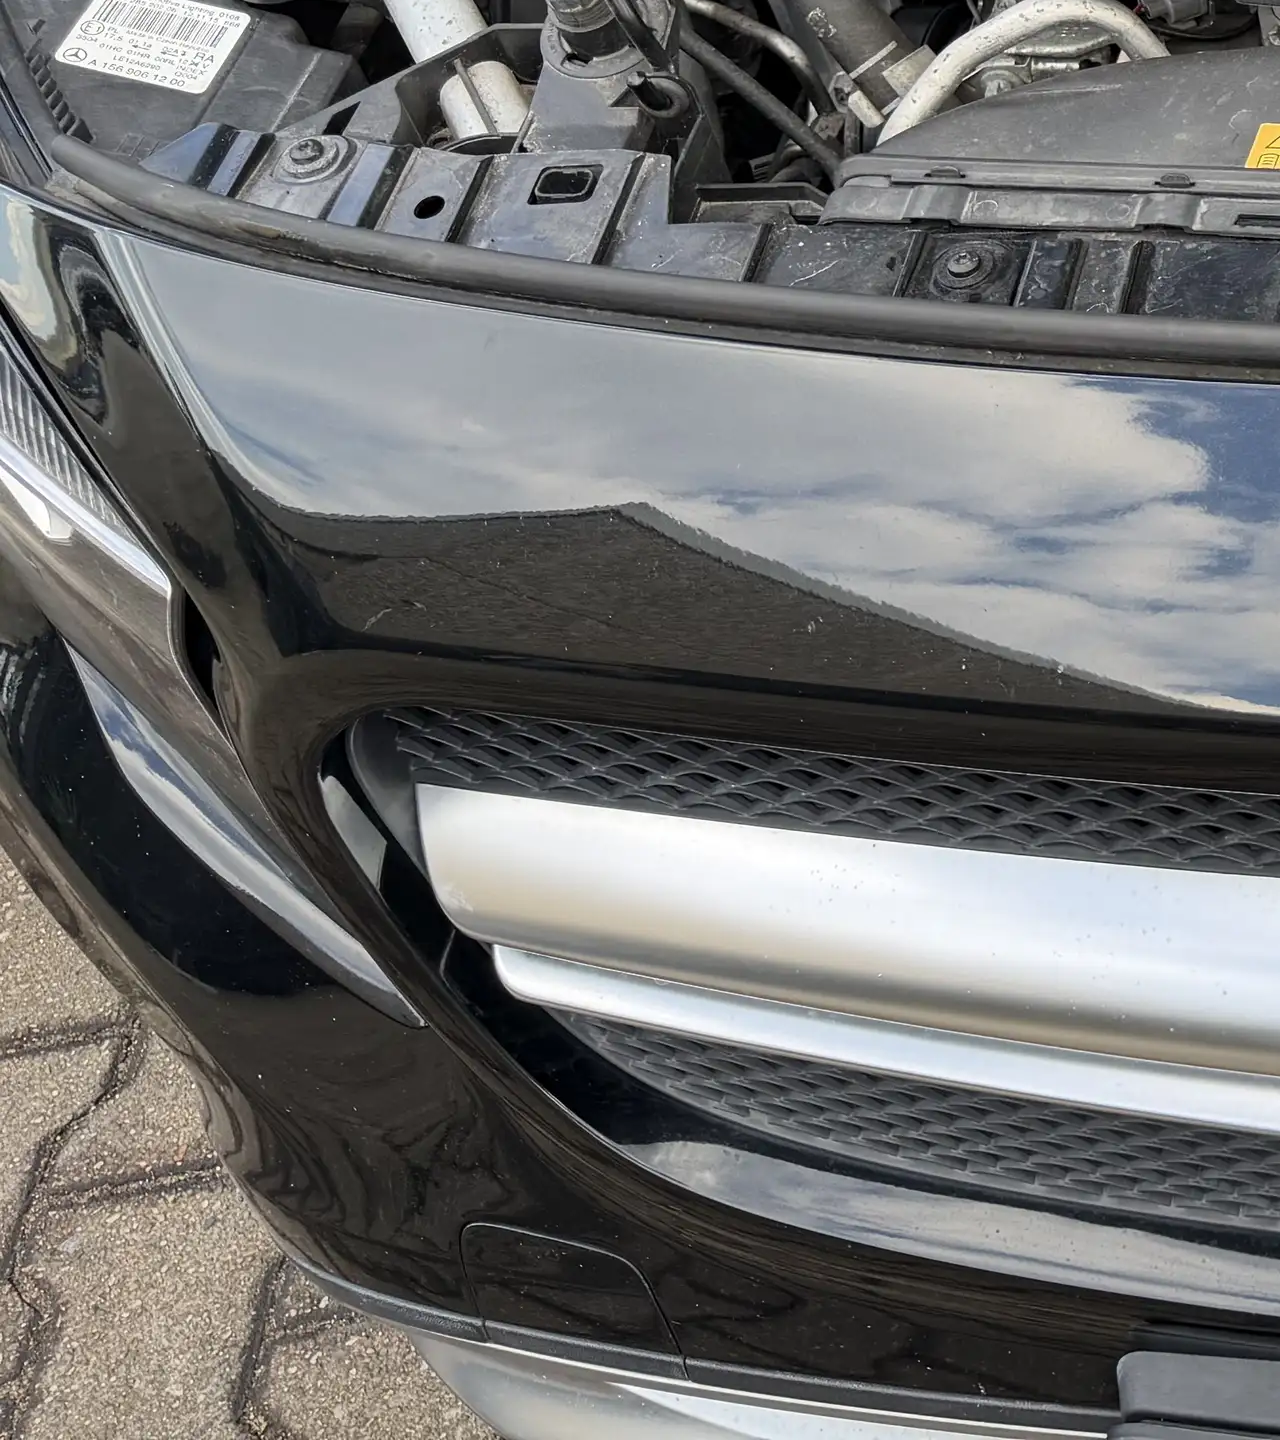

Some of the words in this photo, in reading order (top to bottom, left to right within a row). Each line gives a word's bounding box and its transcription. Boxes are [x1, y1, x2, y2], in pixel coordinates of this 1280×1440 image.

[182, 4, 214, 16] Lighting
[193, 52, 214, 63] RA
[103, 62, 124, 72] 156
[126, 68, 149, 78] 906
[154, 74, 167, 83] 12
[169, 78, 185, 87] 00
